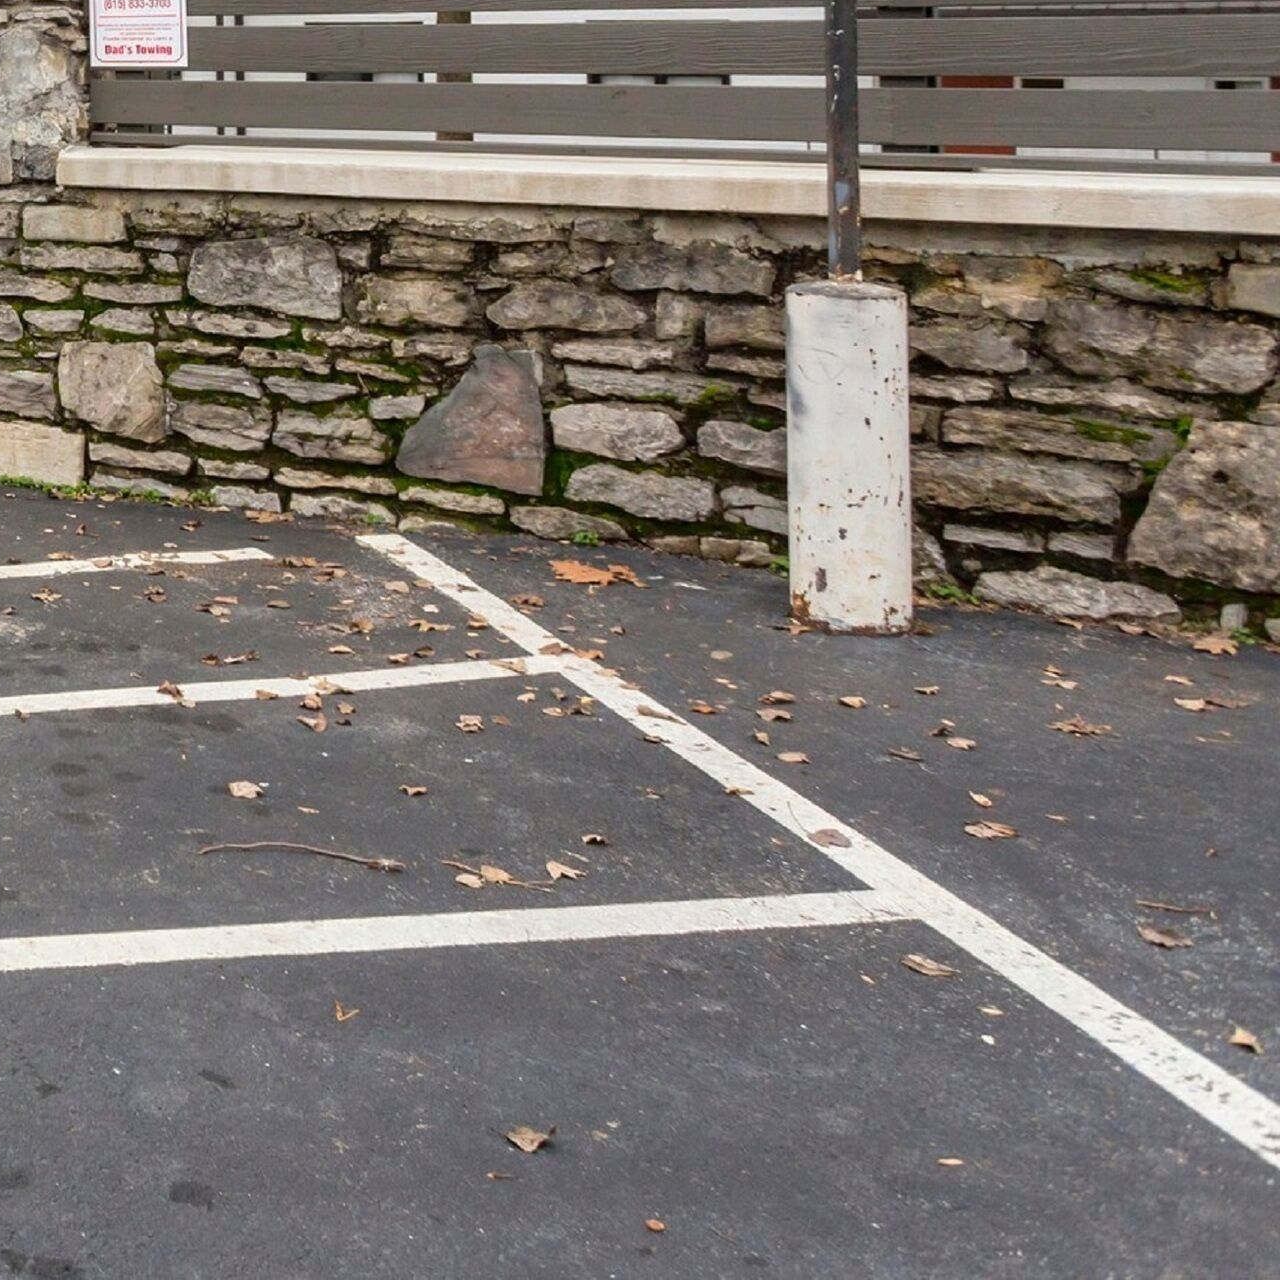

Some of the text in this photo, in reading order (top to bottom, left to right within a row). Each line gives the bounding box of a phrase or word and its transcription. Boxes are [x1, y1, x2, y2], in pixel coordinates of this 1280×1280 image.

[104, 0, 126, 10] (615)
[105, 45, 173, 55] Dad's Towing
